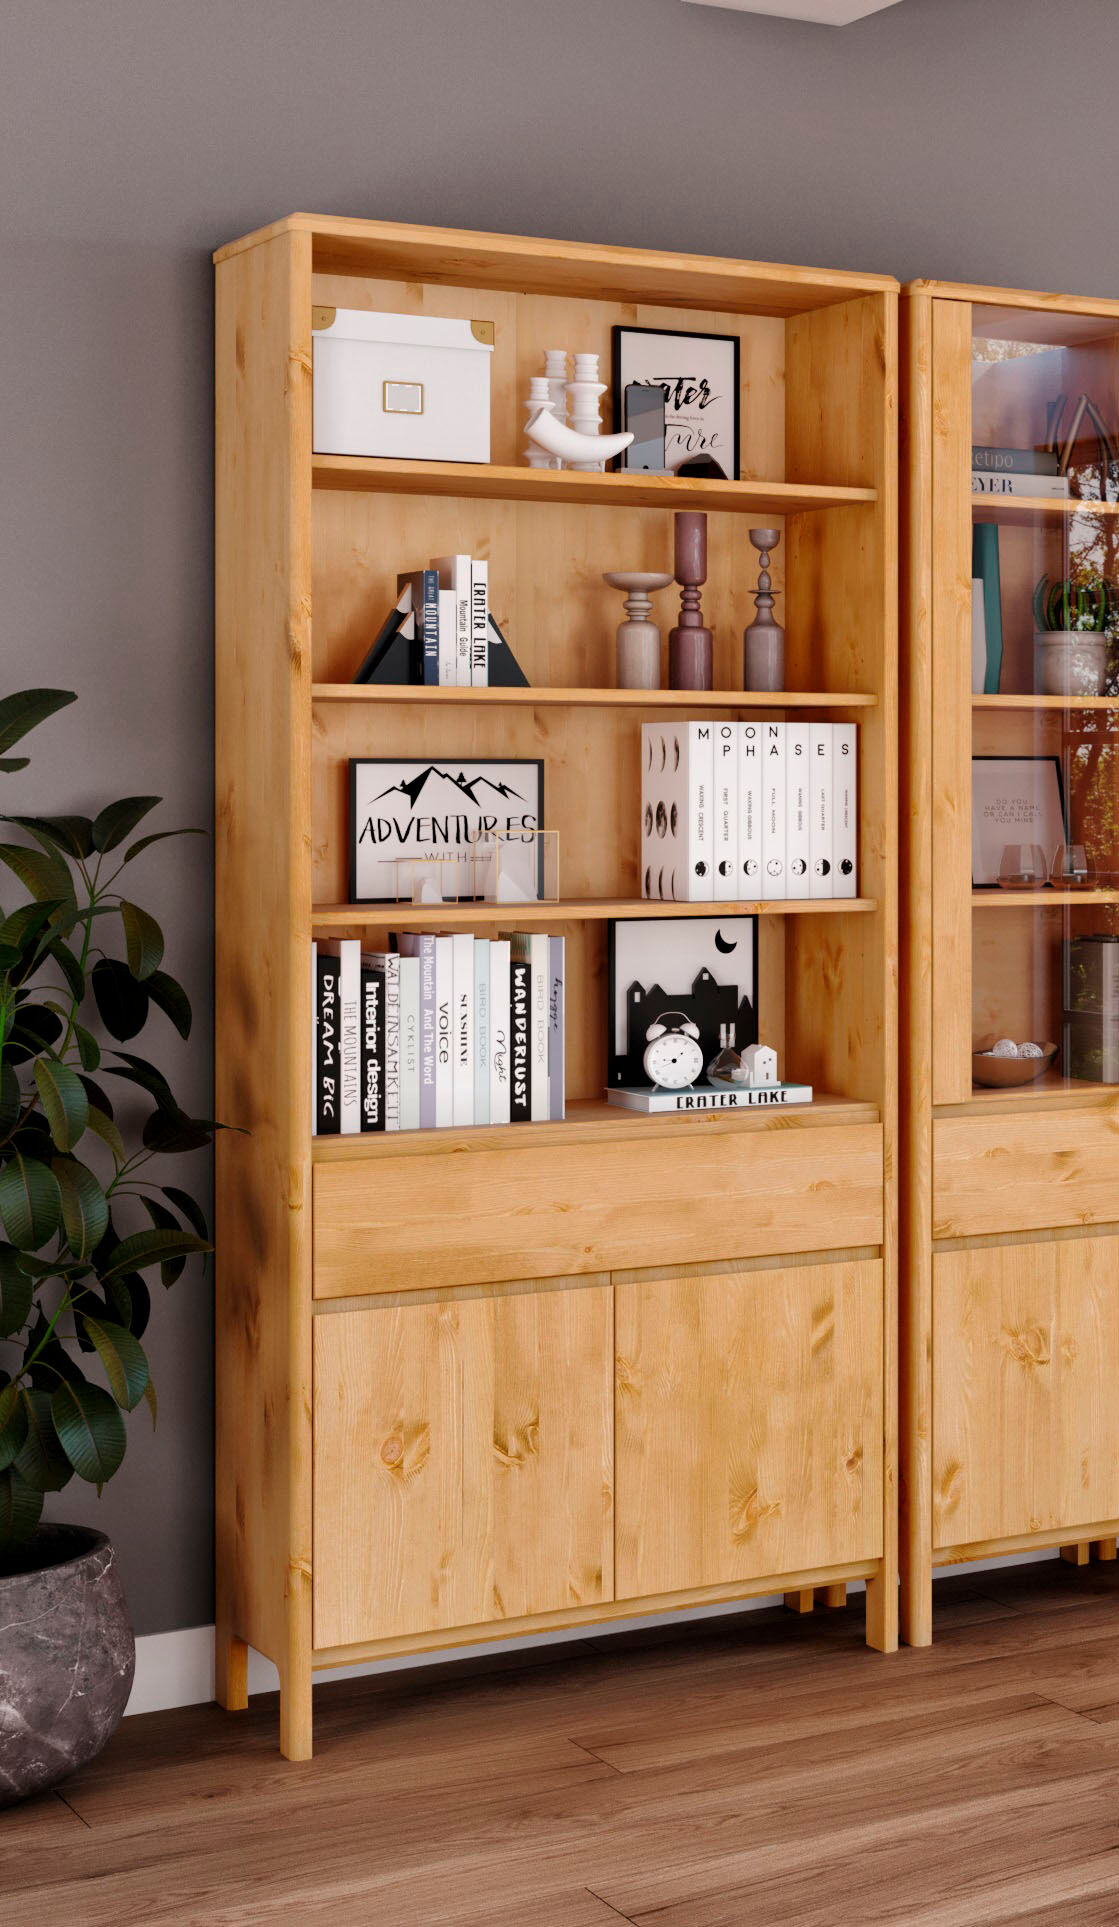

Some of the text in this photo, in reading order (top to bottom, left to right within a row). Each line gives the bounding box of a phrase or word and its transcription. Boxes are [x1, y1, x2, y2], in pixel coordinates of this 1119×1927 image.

[632, 377, 723, 411] ater
[425, 602, 438, 657] MOUNTAIN
[459, 600, 468, 657] Mountain Guide
[473, 582, 487, 669] CRATER LAKE
[698, 726, 779, 740] MOON
[723, 744, 849, 757] PHASES
[358, 814, 537, 844] ADVENTURES
[424, 851, 467, 863] WITH
[322, 974, 335, 1066] DREAM
[423, 936, 435, 1085] The Mountain And The Word
[438, 1002, 452, 1064] voice
[460, 993, 468, 1067] SUNSHINE
[478, 983, 487, 1068] BIRD BOOK
[513, 967, 527, 1107] WANDERLUST
[536, 974, 545, 1065] BIRD BOOK
[343, 1001, 358, 1107] THE MOUNTAINS
[363, 981, 382, 1124] Interior design
[406, 1014, 416, 1073] CYKLIST
[676, 1090, 789, 1109] CRATER LAKE
